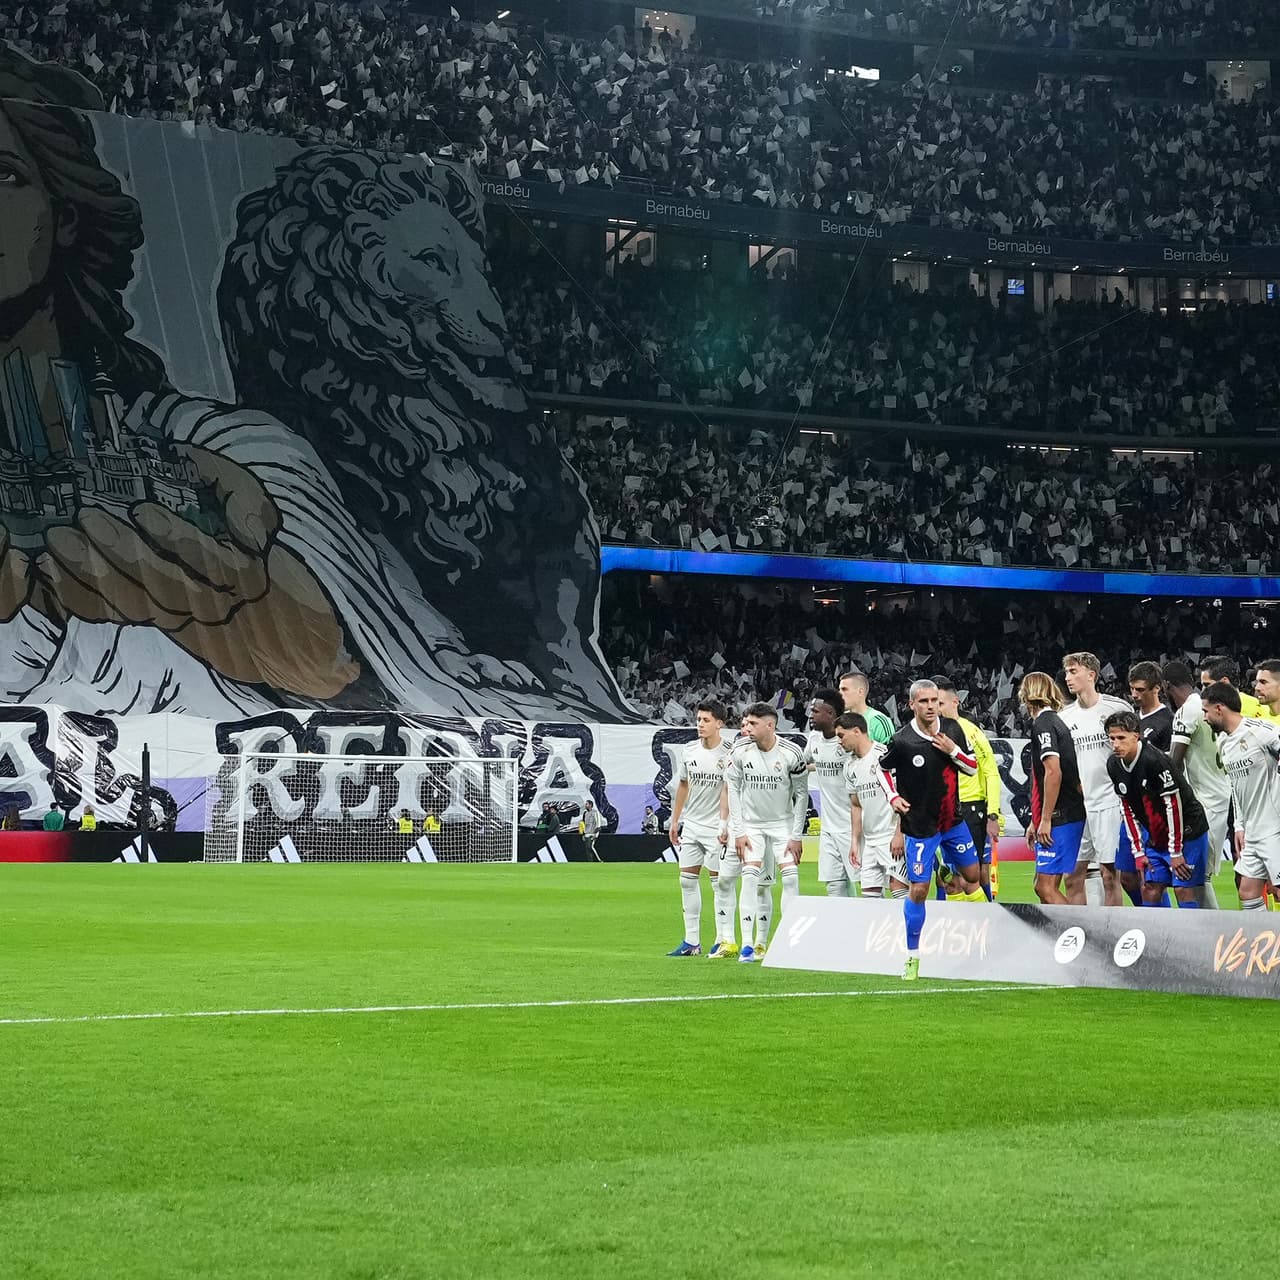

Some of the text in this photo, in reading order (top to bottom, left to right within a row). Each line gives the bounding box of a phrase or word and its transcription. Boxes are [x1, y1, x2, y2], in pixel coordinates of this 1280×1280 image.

[646, 199, 711, 221] Bernabéu
[821, 219, 884, 239] Bernabéu
[987, 236, 1052, 257] Bernabéu
[1163, 247, 1230, 264] Bernabéu
[1037, 732, 1052, 744] VS
[745, 773, 783, 782] Emirates
[1158, 770, 1173, 783] VS
[915, 843, 925, 862] 7
[1062, 935, 1078, 947] EA
[1120, 937, 1138, 950] EA
